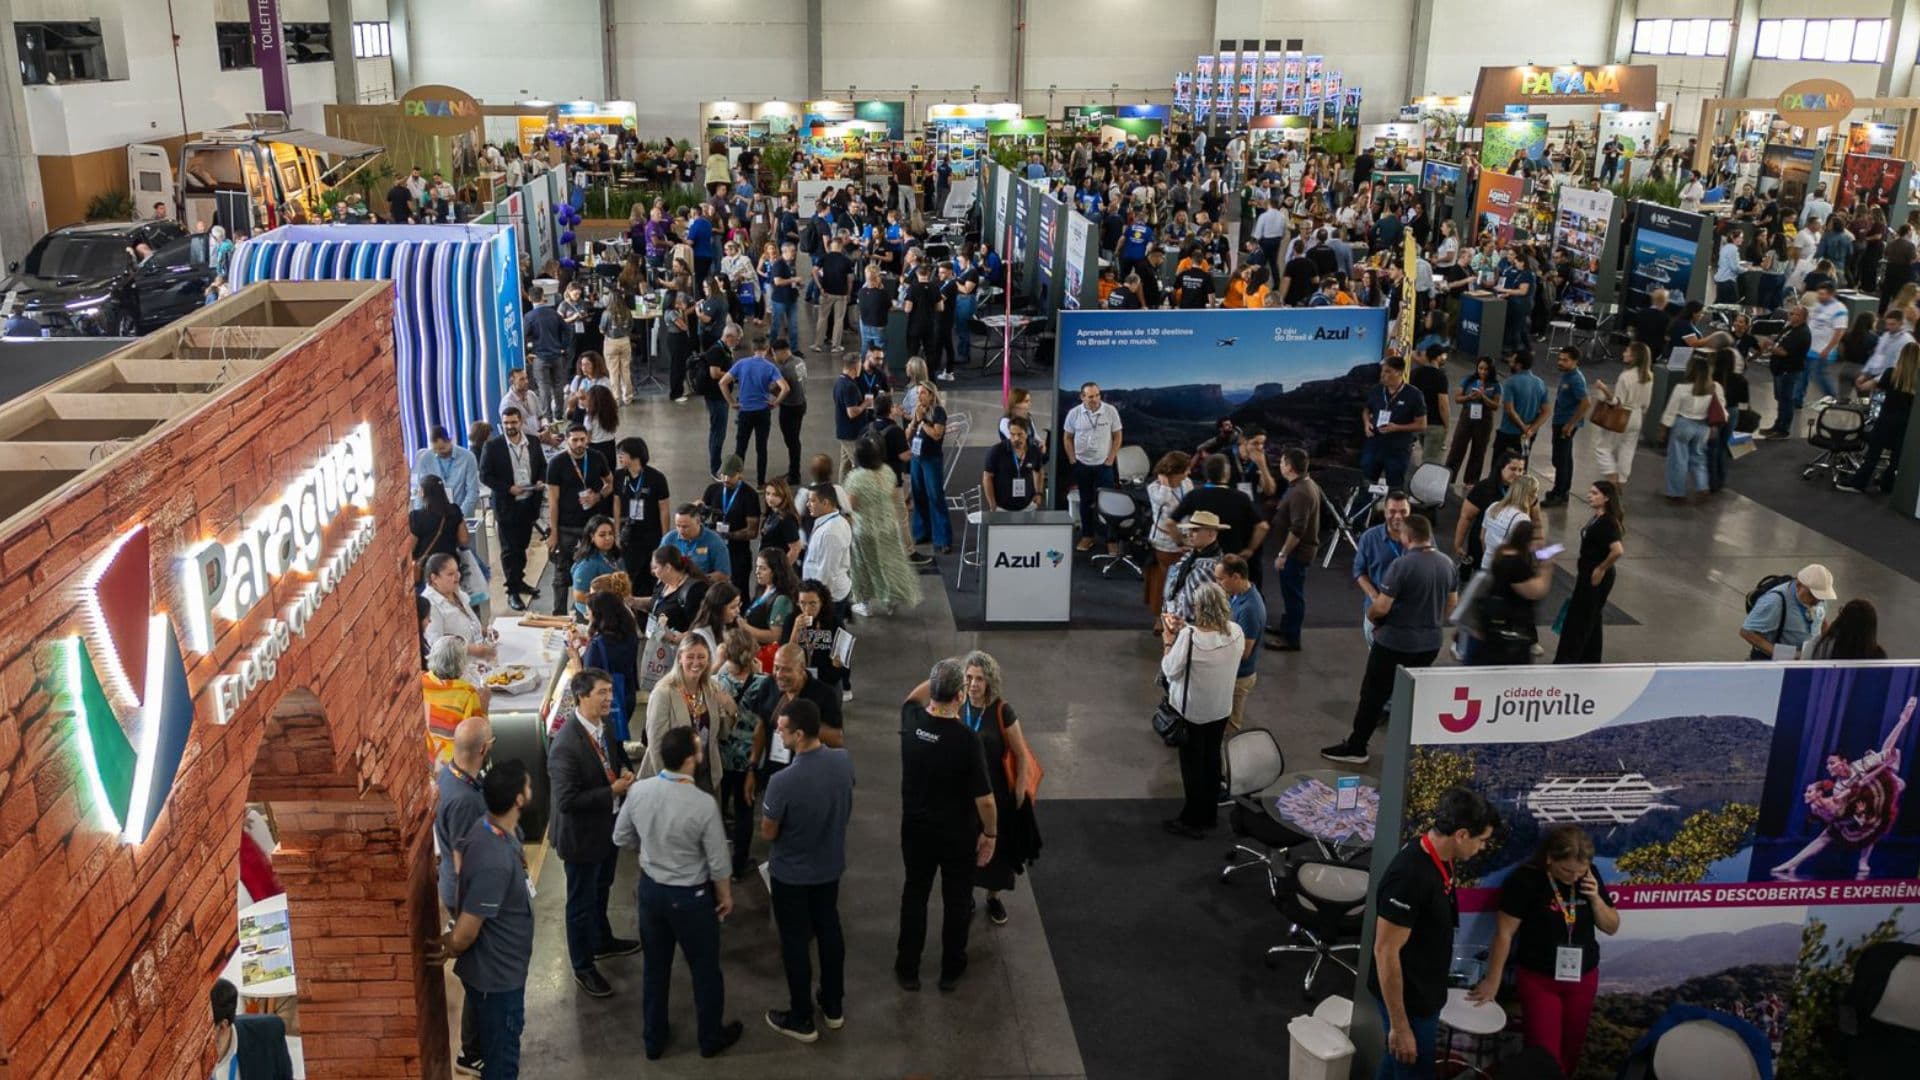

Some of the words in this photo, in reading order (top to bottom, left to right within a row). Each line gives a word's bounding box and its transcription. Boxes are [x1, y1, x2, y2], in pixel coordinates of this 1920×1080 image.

[1115, 328, 1133, 336] mais
[1135, 328, 1144, 336] de
[1275, 327, 1282, 335] O
[1314, 326, 1350, 340] Azul
[1088, 338, 1110, 346] Brasil
[994, 552, 1040, 568] Azul
[1503, 687, 1543, 698] cidade
[1547, 686, 1561, 697] de
[1486, 693, 1596, 724] Joinville
[1633, 889, 1712, 904] INFINITAS
[1715, 886, 1827, 902] DESCOBERTAS
[1830, 886, 1840, 899] E
[1843, 882, 1920, 898] EXPERIÊN
